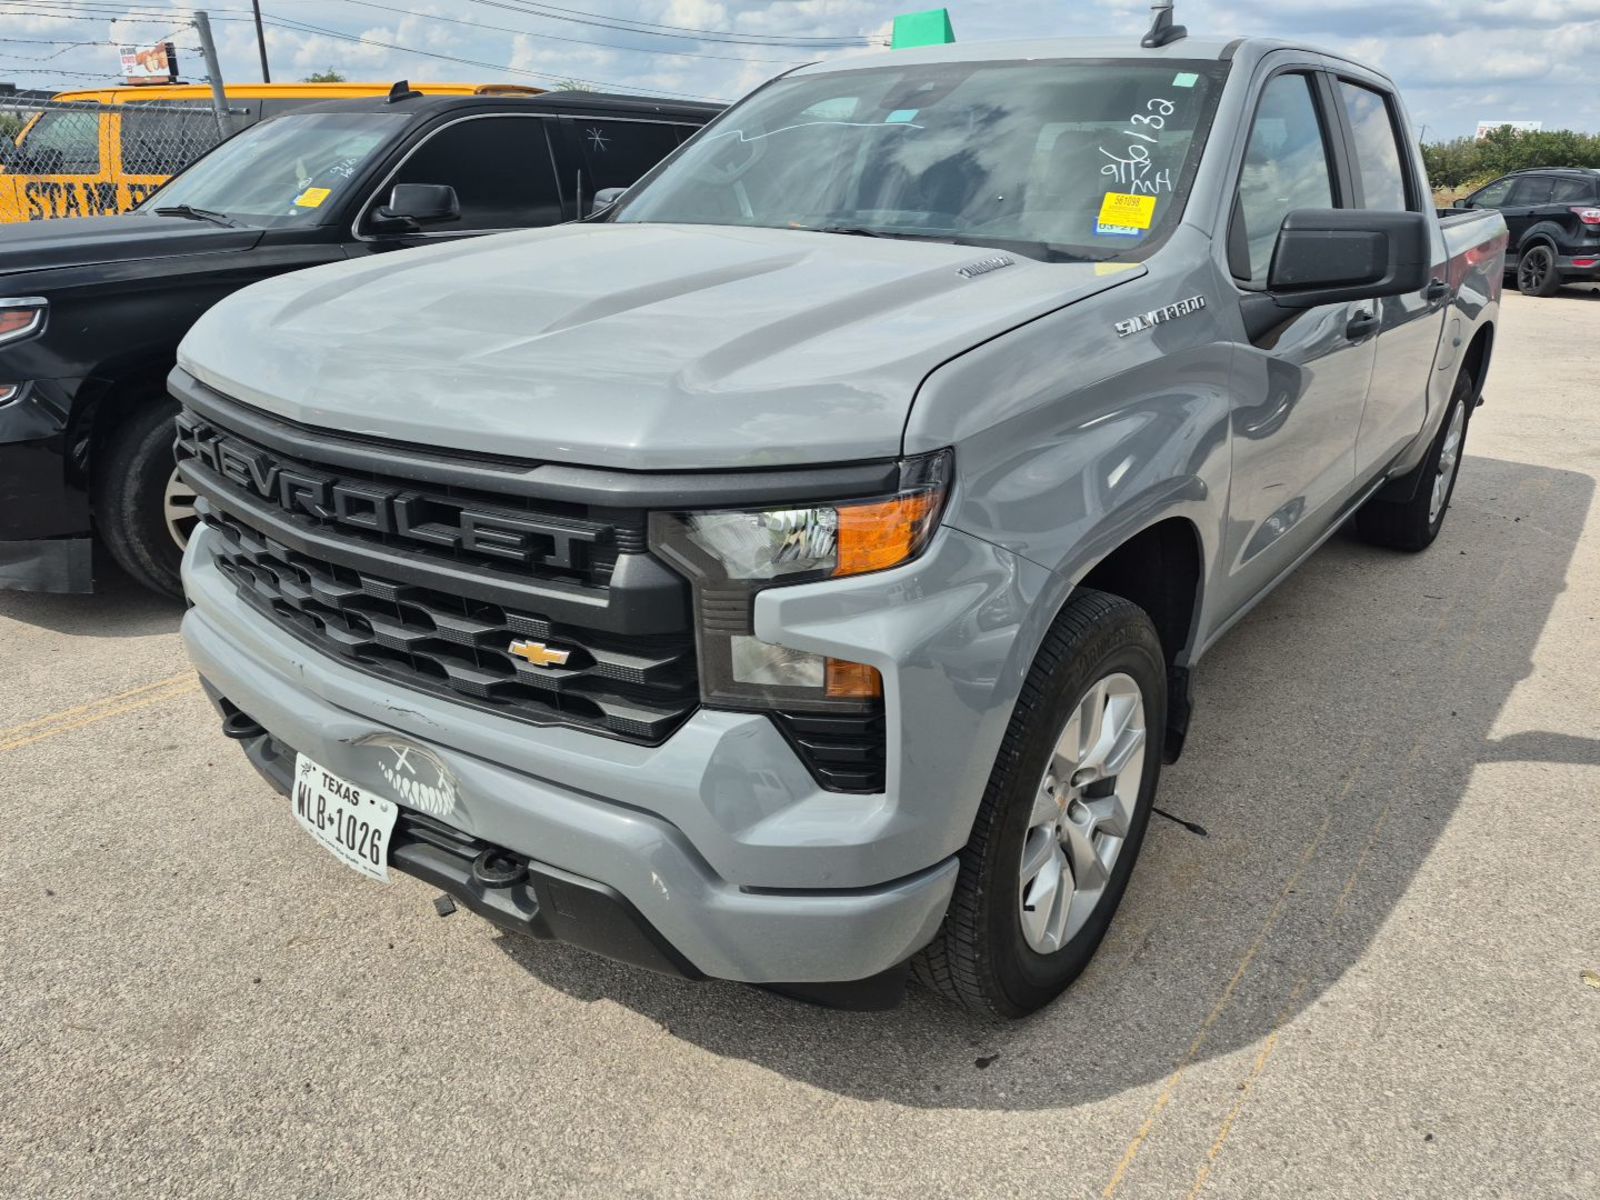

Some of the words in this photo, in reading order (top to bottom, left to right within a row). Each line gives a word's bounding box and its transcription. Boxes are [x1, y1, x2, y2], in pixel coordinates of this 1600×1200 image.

[25, 181, 159, 221] STAMP
[1114, 295, 1206, 338] SILVERADO
[173, 410, 614, 570] CHEVROLET
[321, 772, 361, 806] TEXAS
[335, 808, 383, 866] 1026
